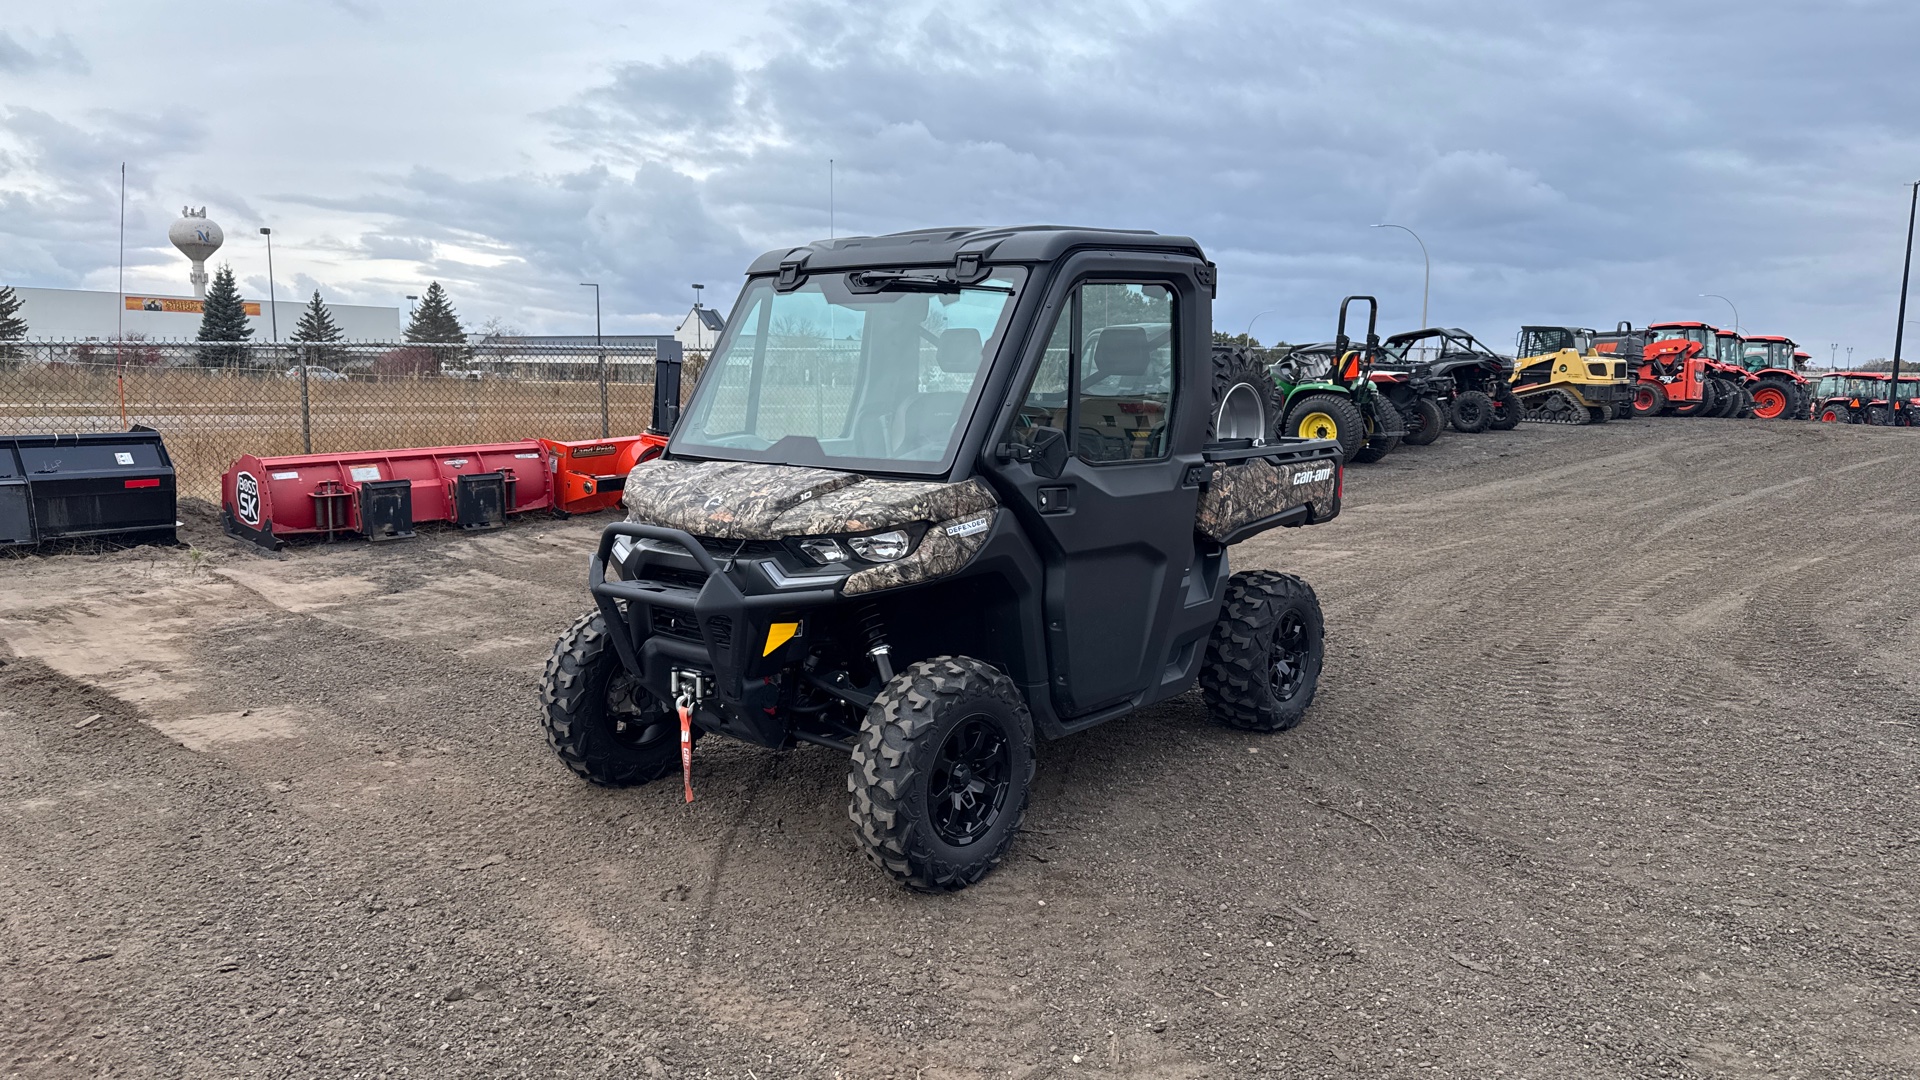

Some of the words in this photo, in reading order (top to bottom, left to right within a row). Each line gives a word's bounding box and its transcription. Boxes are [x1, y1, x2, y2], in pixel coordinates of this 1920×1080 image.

[239, 476, 256, 496] BOSS
[1293, 468, 1330, 486] can-am
[240, 492, 257, 520] SK
[948, 519, 986, 535] DEFENDER
